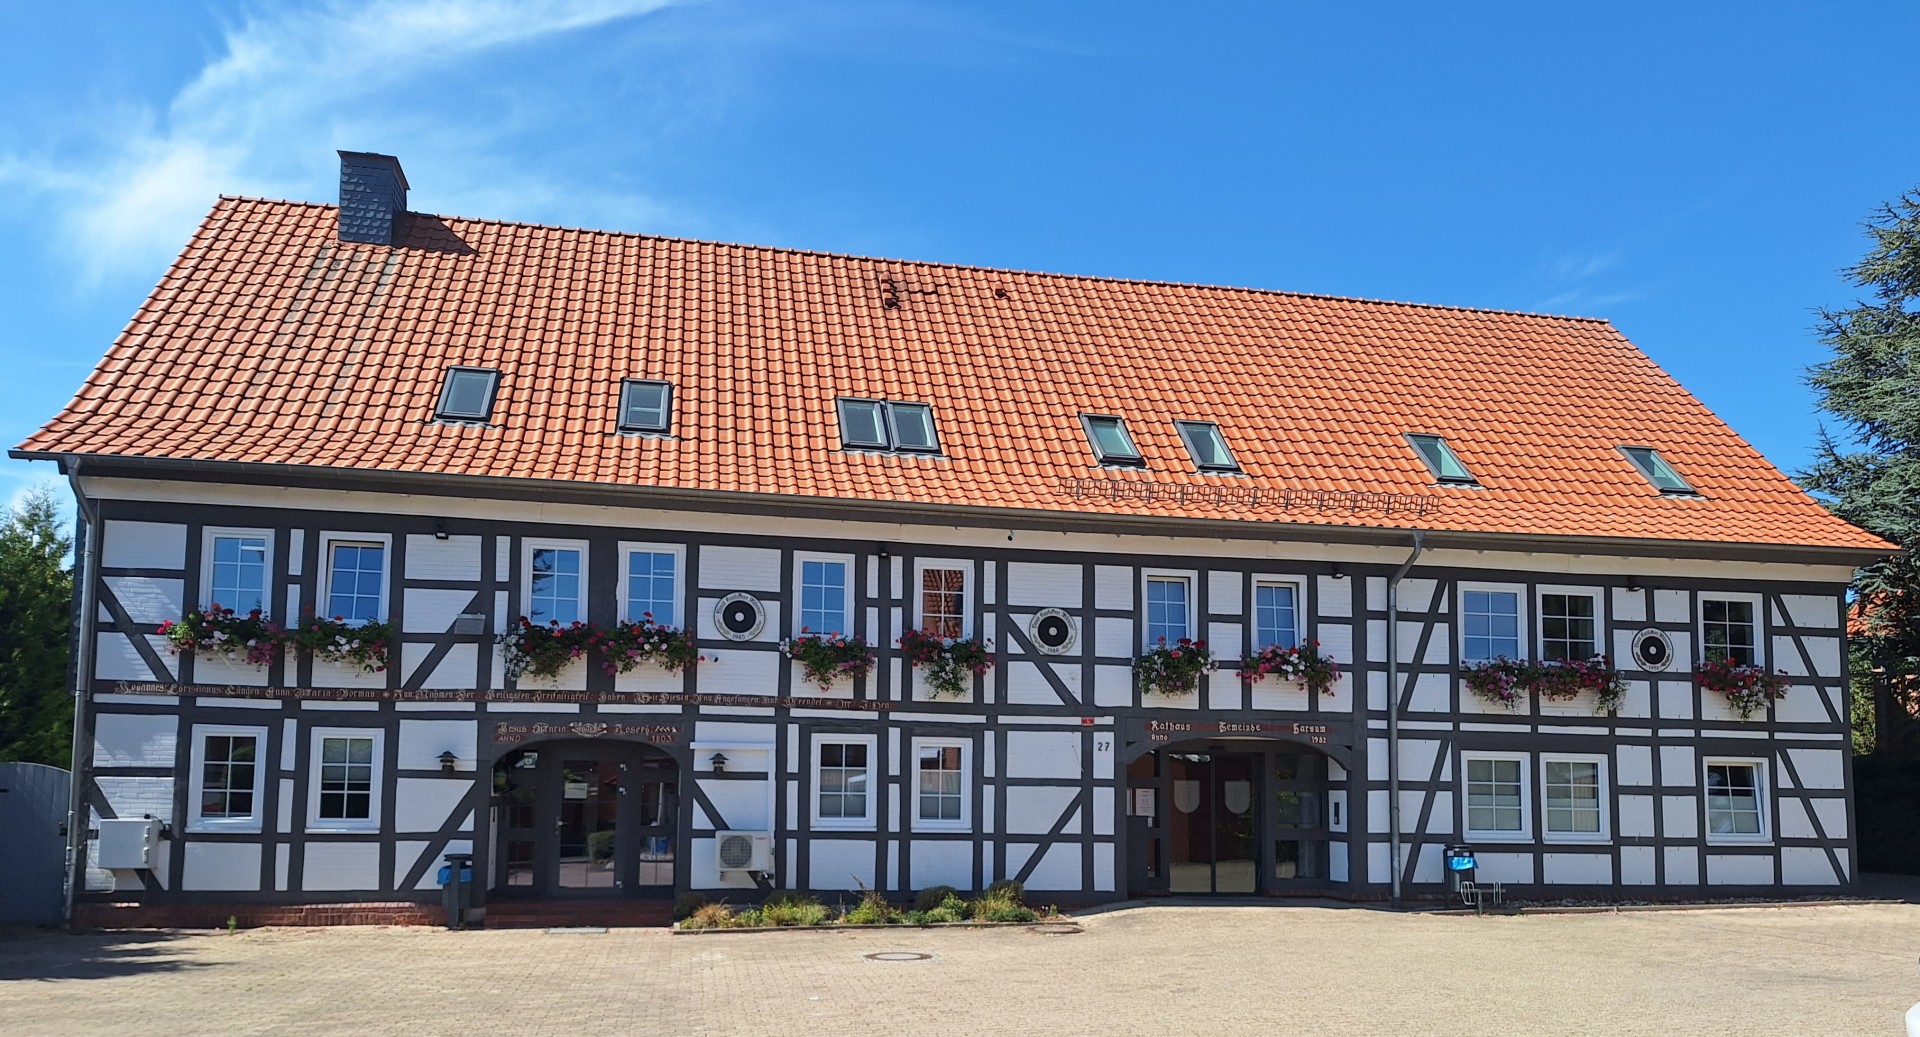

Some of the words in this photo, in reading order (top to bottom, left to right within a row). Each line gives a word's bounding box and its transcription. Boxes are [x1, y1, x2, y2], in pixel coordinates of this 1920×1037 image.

[498, 722, 527, 734] Jesus
[1151, 720, 1191, 731] Rathaus
[1219, 720, 1261, 732] Gemeinde
[1292, 723, 1327, 735] Harsum
[651, 735, 673, 743] 1803
[1097, 742, 1110, 752] 27
